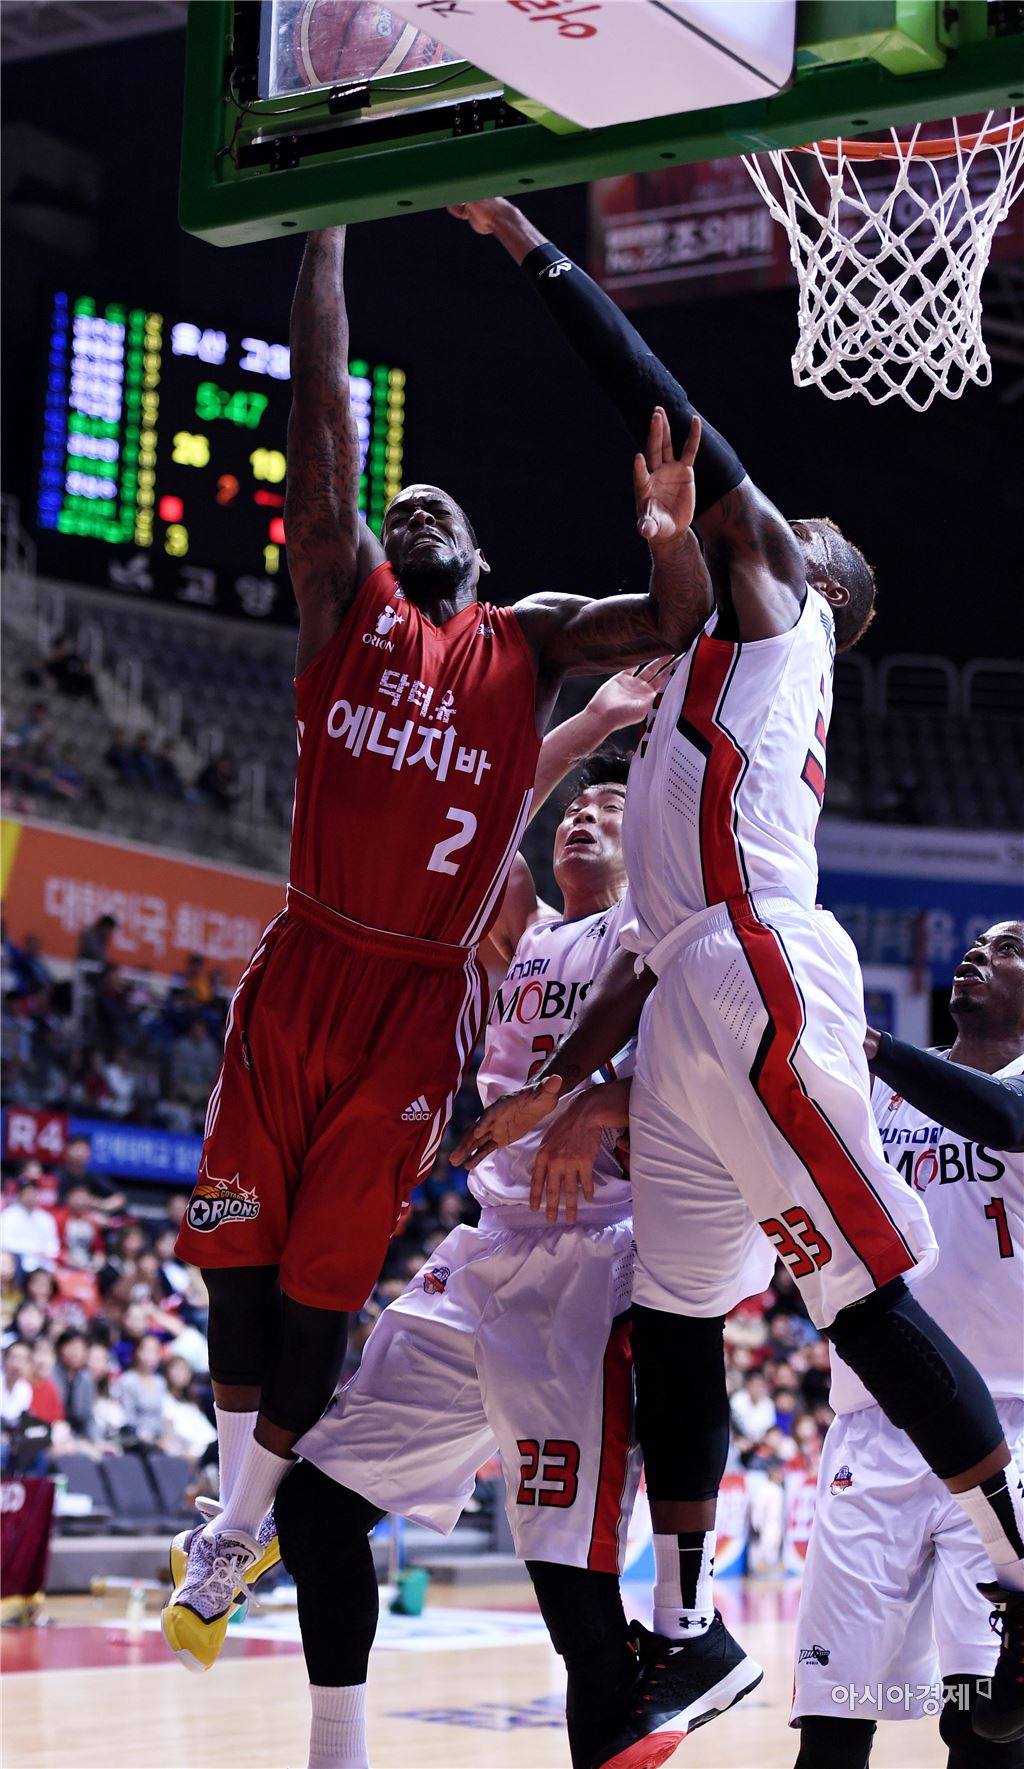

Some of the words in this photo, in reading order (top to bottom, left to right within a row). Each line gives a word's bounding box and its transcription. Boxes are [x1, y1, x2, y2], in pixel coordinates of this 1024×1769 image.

[195, 381, 268, 430] 5:47
[362, 633, 395, 653] ORION
[426, 806, 478, 876] 2
[7, 1113, 65, 1156] R4
[401, 1111, 433, 1121] adida
[190, 1199, 259, 1226] ORIONS
[984, 1197, 1014, 1258] 1
[759, 1206, 832, 1279] 33
[516, 1439, 580, 1508] 23
